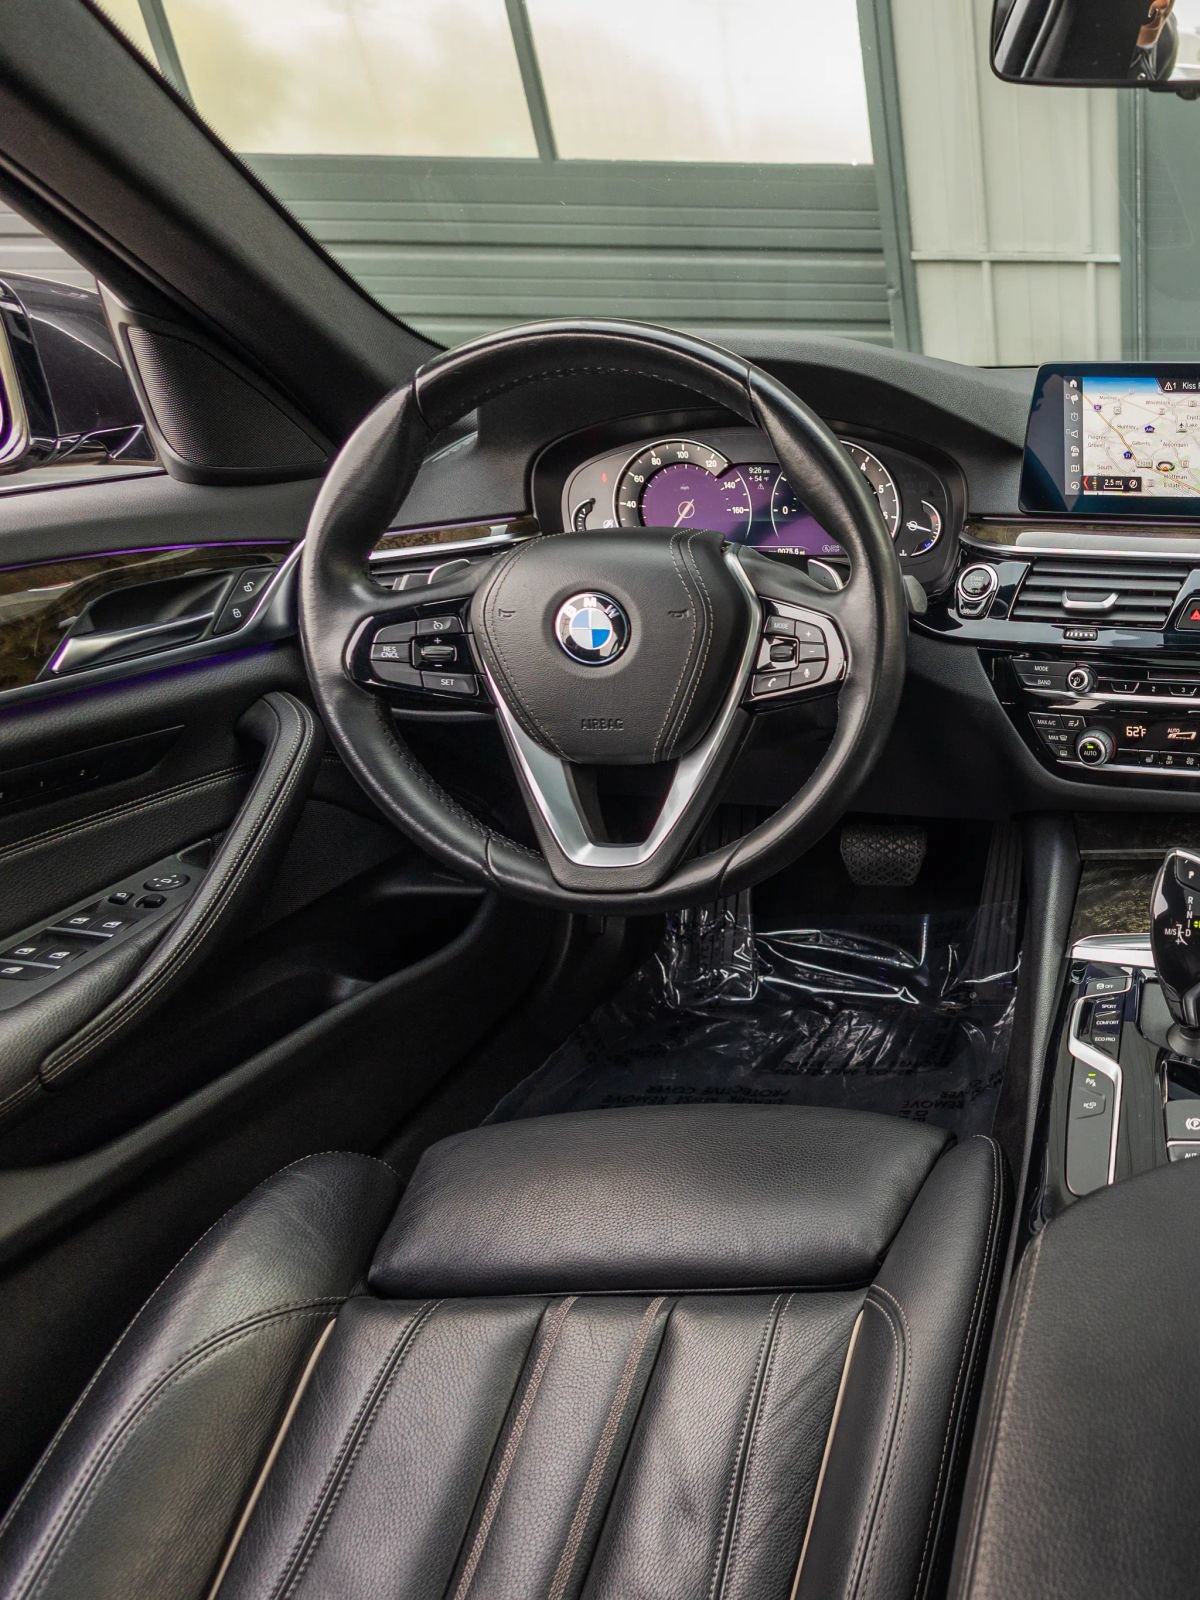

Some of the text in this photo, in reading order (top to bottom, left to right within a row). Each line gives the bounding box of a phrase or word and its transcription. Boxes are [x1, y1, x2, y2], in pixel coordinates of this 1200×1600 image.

[676, 451, 689, 459] 100
[651, 457, 661, 466] 80
[705, 460, 717, 468] 120
[860, 462, 866, 472] 4
[633, 474, 644, 483] 60
[723, 481, 736, 489] 140
[878, 484, 884, 494] 5
[731, 506, 744, 514] 160
[782, 505, 789, 514] 0
[563, 597, 620, 619] BMW
[440, 678, 455, 686] SET
[581, 718, 624, 731] AIRBAG
[1125, 725, 1147, 737] 62°F
[1188, 870, 1195, 879] P
[1187, 896, 1194, 905] R
[1186, 911, 1193, 919] N
[1164, 928, 1177, 936] M/S
[1185, 929, 1192, 937] D
